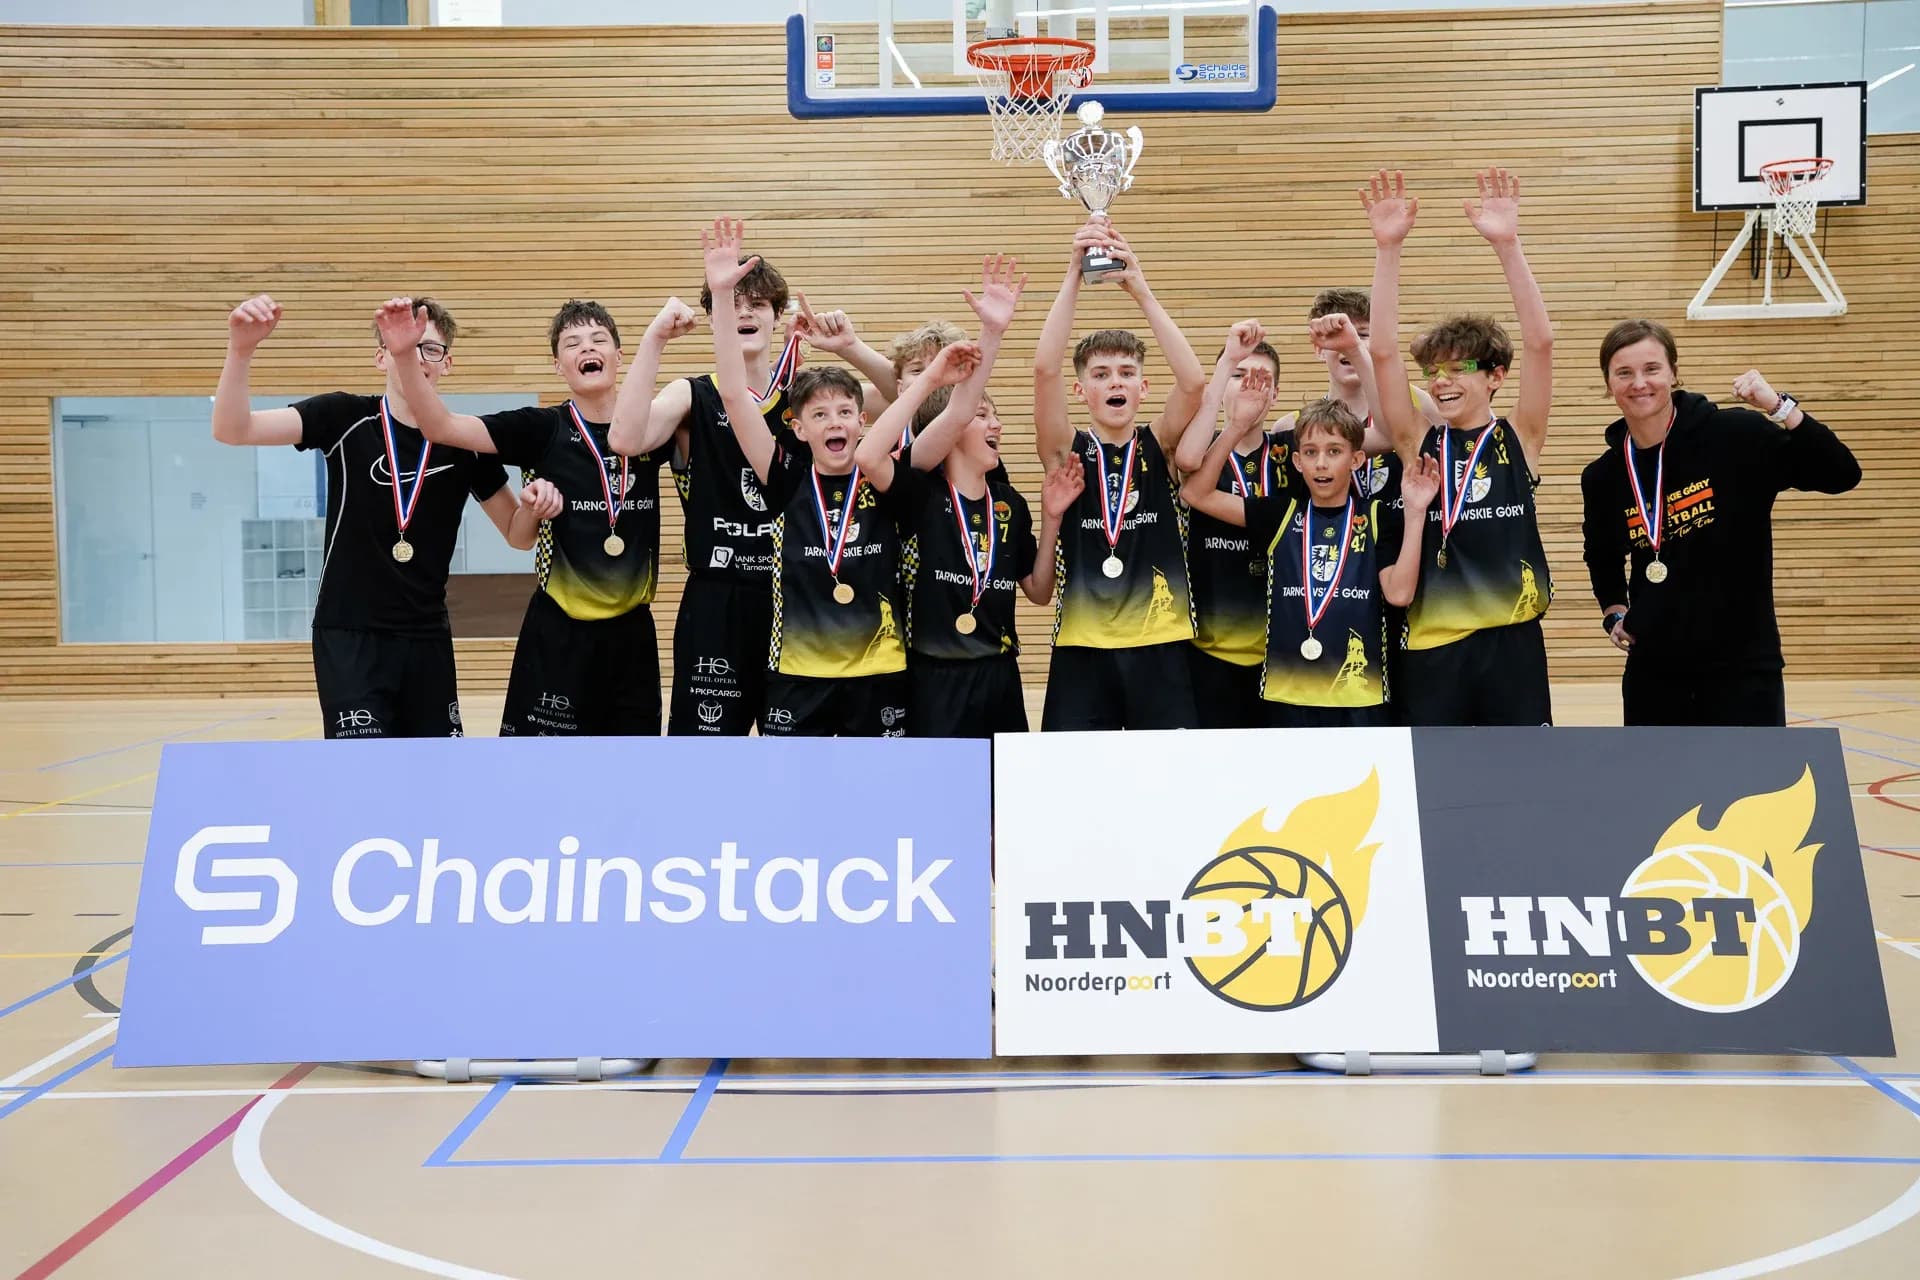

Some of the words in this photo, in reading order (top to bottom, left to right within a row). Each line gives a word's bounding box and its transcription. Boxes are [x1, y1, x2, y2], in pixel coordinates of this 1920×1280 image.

[1199, 72, 1247, 80] Sports
[1682, 478, 1710, 496] GÓRY
[1136, 509, 1158, 524] GÓRY
[1495, 504, 1525, 518] GÓRY
[1000, 523, 1009, 543] 7
[993, 577, 1015, 591] GÓRY
[1341, 586, 1370, 600] GÓRY
[331, 836, 956, 926] Chainstack
[1024, 897, 1313, 960] HNBT
[1460, 896, 1757, 957] HNBT
[1025, 972, 1172, 995] Noorderpoort
[1467, 968, 1618, 993] Noorderpoort
